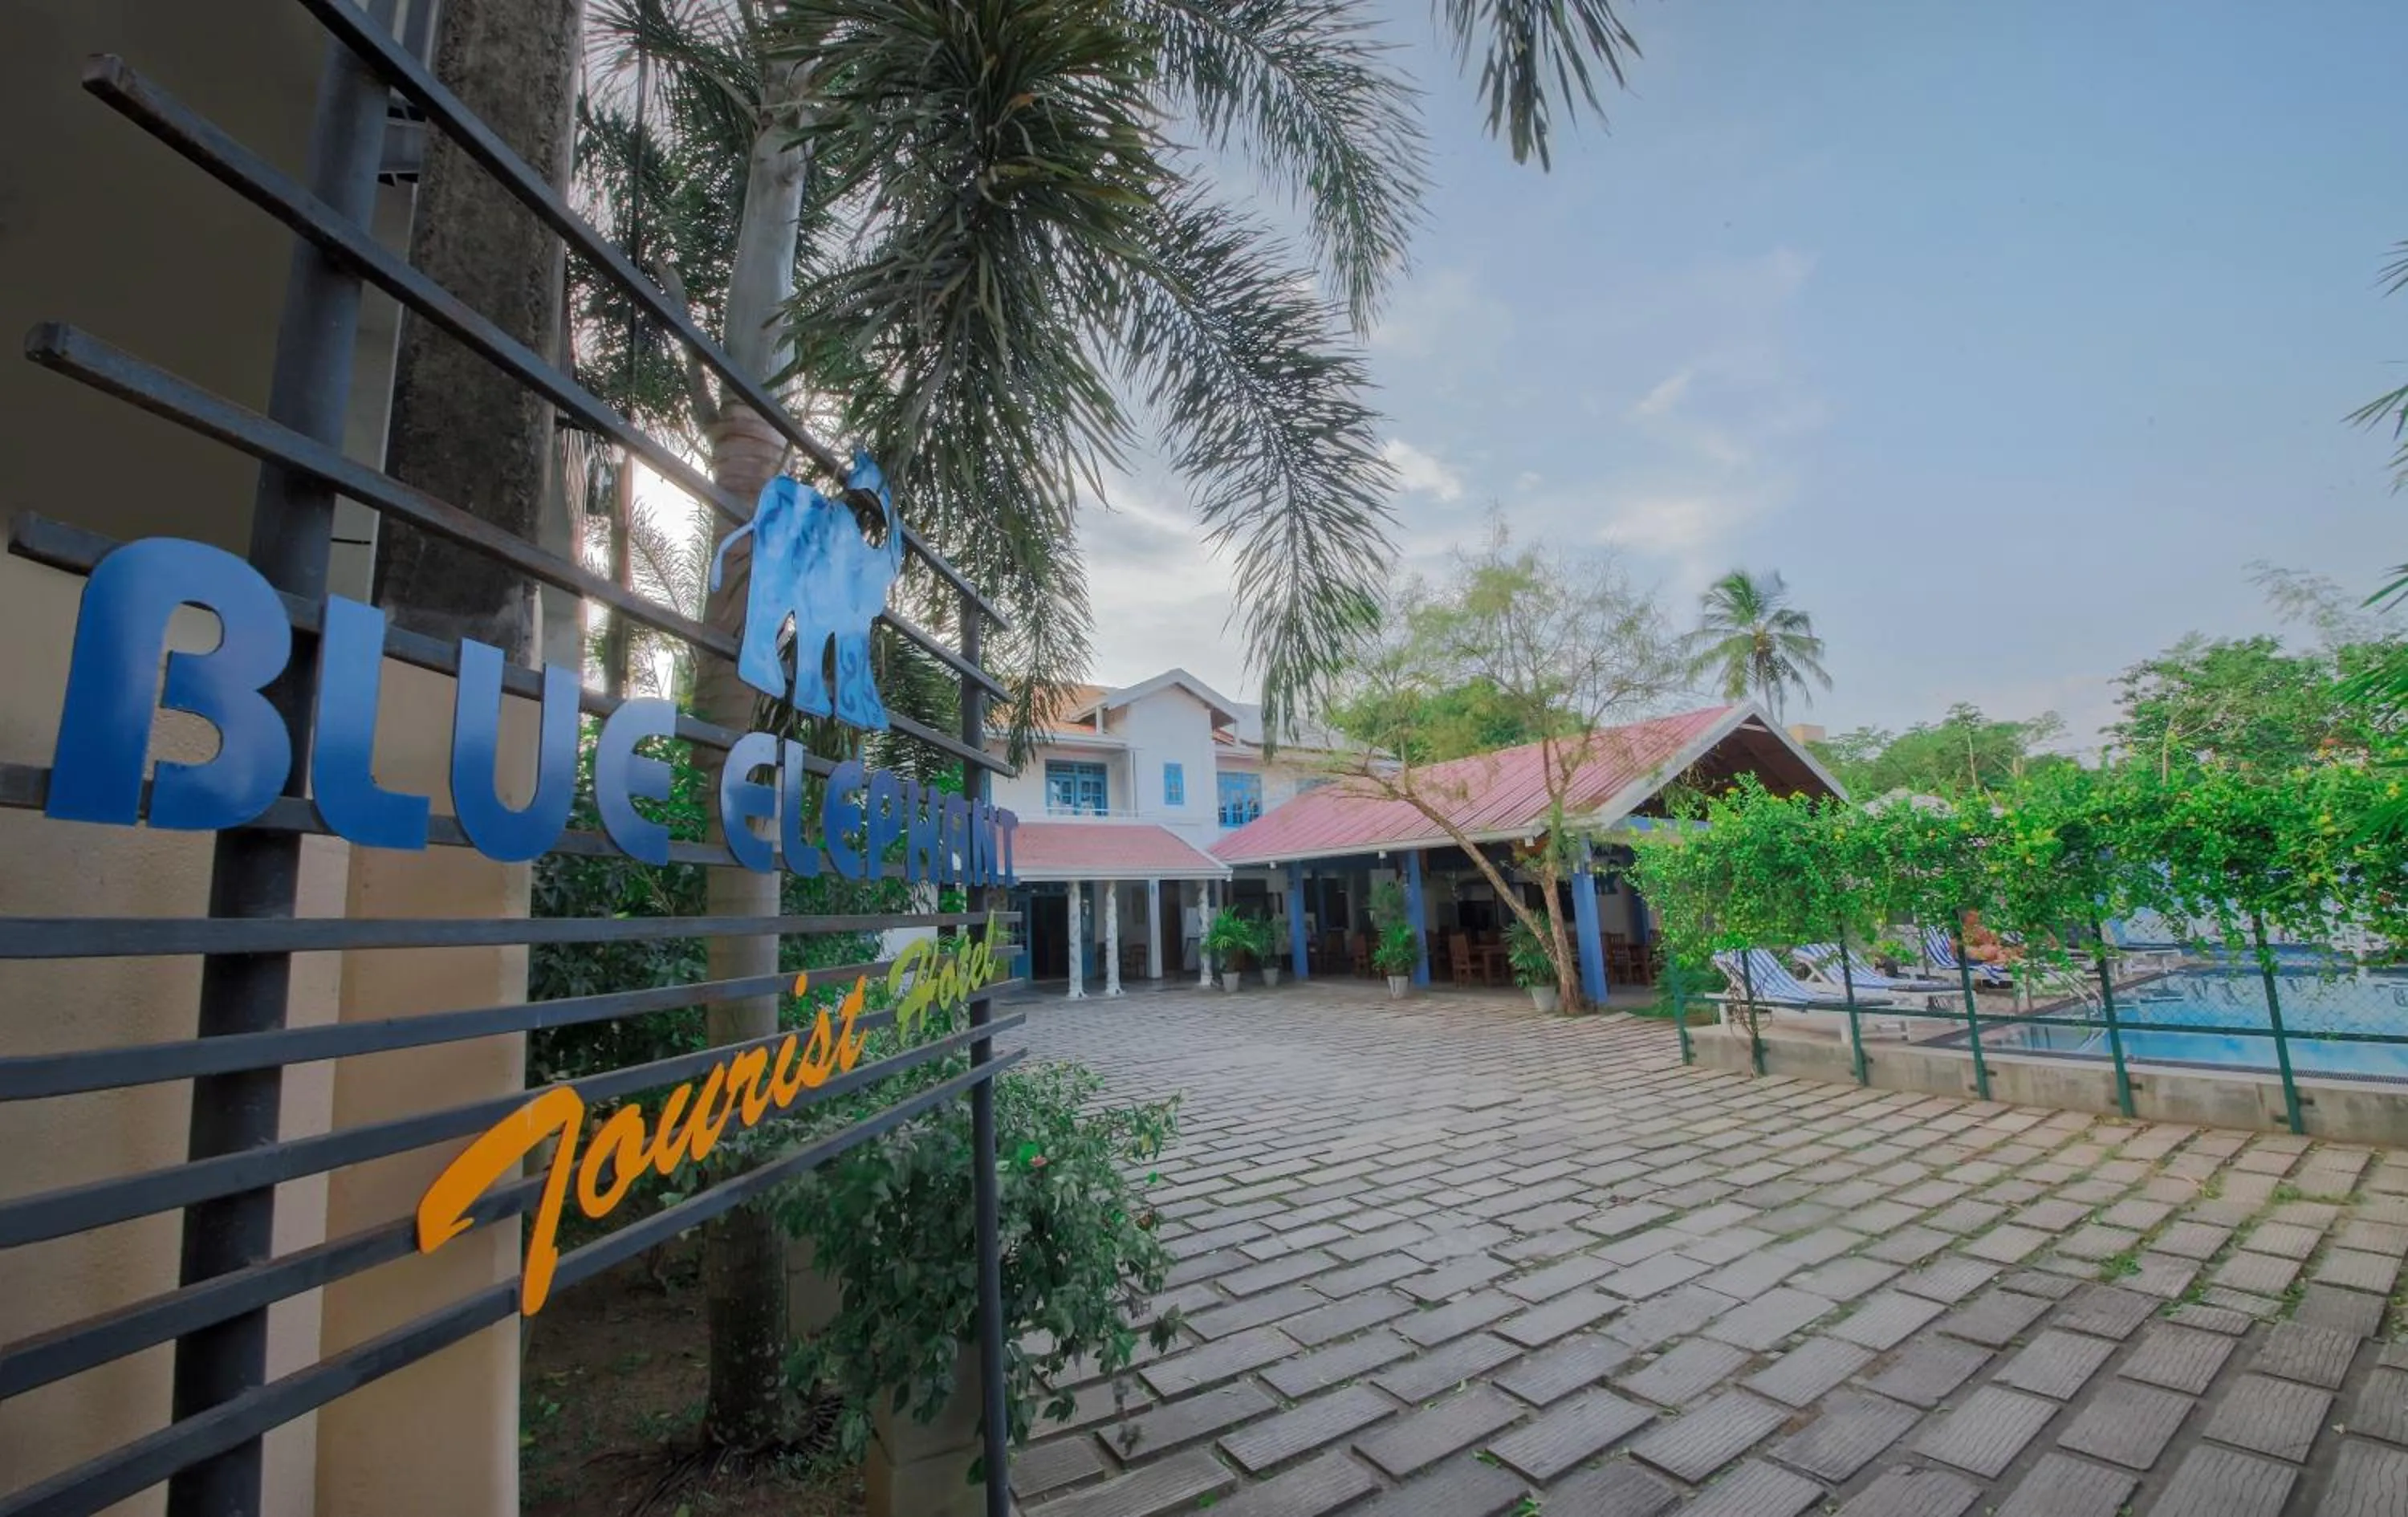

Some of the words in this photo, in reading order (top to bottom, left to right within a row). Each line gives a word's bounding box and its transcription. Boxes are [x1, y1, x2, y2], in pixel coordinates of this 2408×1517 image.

[45, 536, 677, 865] BLUE
[721, 731, 1019, 887] ELEPHANT
[417, 972, 868, 1318] Tourist
[888, 909, 998, 1046] Hotel
